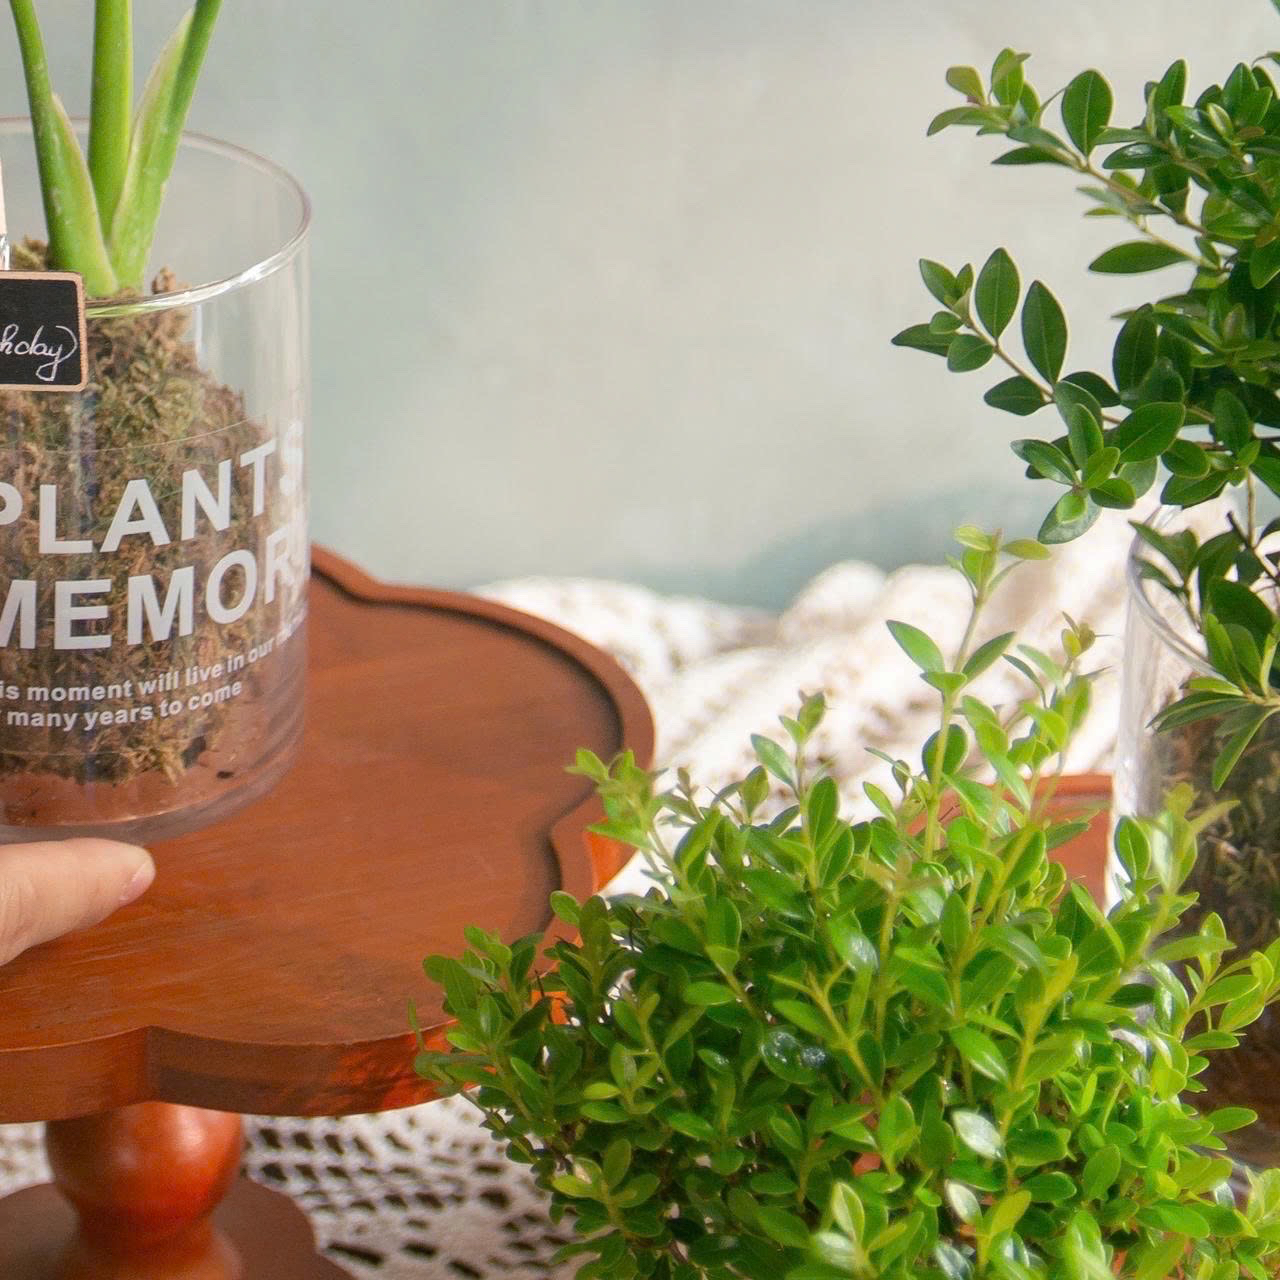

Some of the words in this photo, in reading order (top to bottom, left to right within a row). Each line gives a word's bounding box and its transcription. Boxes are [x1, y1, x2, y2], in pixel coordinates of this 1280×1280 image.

[27, 680, 133, 702] moment
[138, 671, 179, 696] will
[185, 662, 223, 687] live
[227, 654, 245, 673] in
[248, 639, 274, 663] our
[7, 710, 78, 732] many
[83, 705, 154, 731] years
[159, 699, 183, 718] to
[187, 680, 242, 711] come
